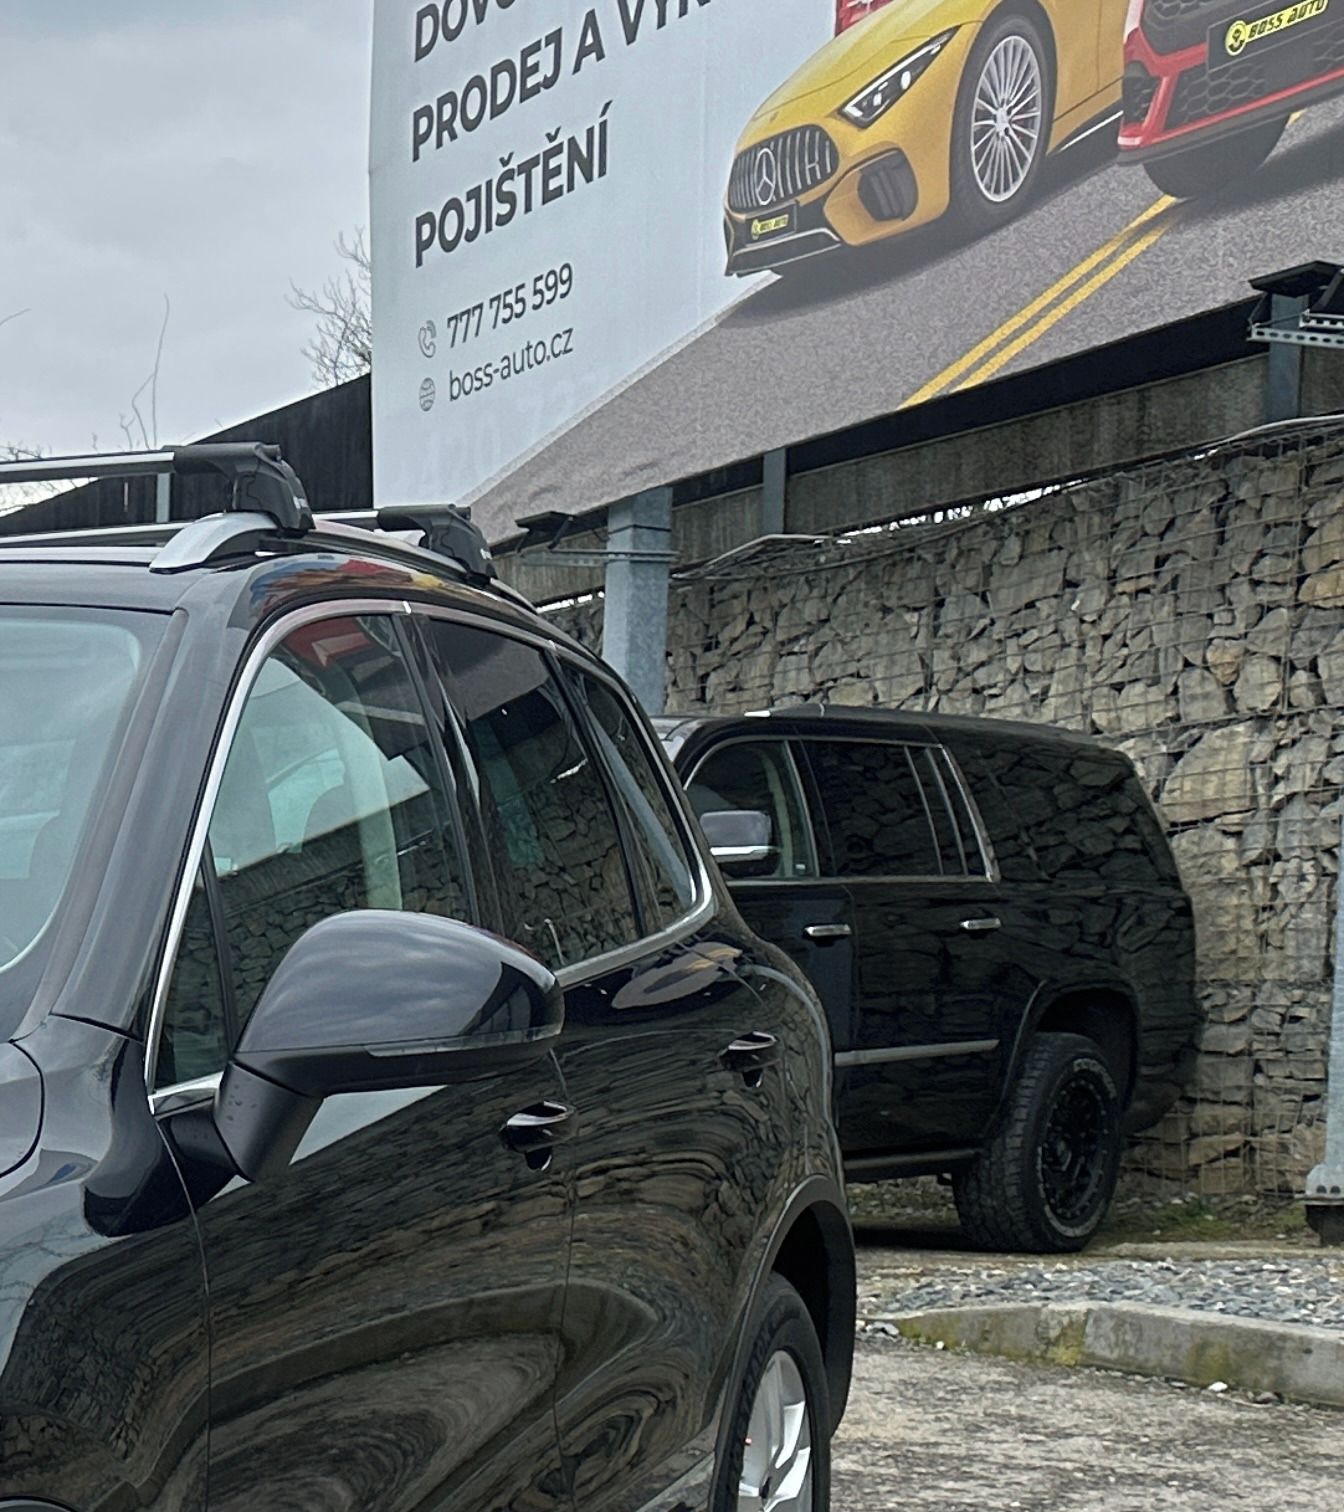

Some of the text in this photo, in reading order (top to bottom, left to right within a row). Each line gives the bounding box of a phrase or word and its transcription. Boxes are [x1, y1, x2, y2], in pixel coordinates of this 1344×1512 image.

[414, 0, 515, 62] DOV
[1247, 12, 1284, 40] BOSS
[412, 26, 563, 163] PRODEJ
[571, 8, 606, 76] A
[415, 99, 613, 269] POJIŠTĚNÍ
[447, 262, 573, 349] 777 755 599
[449, 327, 574, 402] boss-auto.cz
